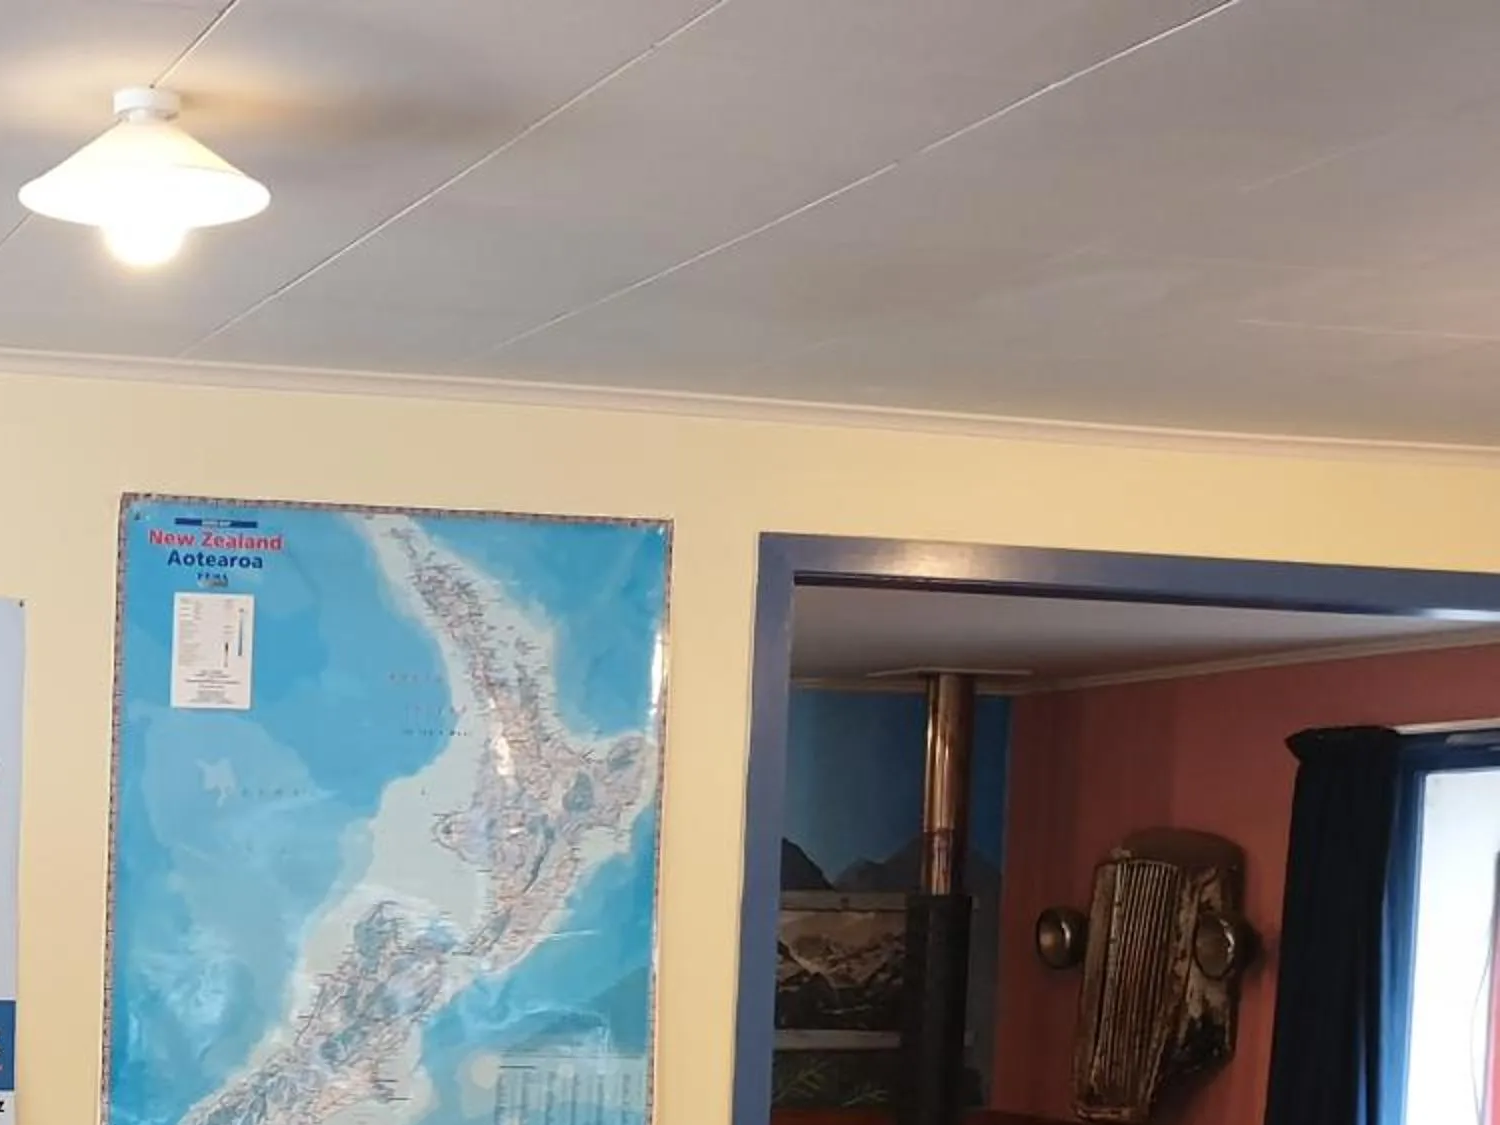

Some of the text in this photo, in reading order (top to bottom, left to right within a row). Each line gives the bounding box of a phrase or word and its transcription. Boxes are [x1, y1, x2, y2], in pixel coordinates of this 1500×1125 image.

[150, 529, 282, 550] New Zealand
[168, 549, 263, 569] Aotearoa
